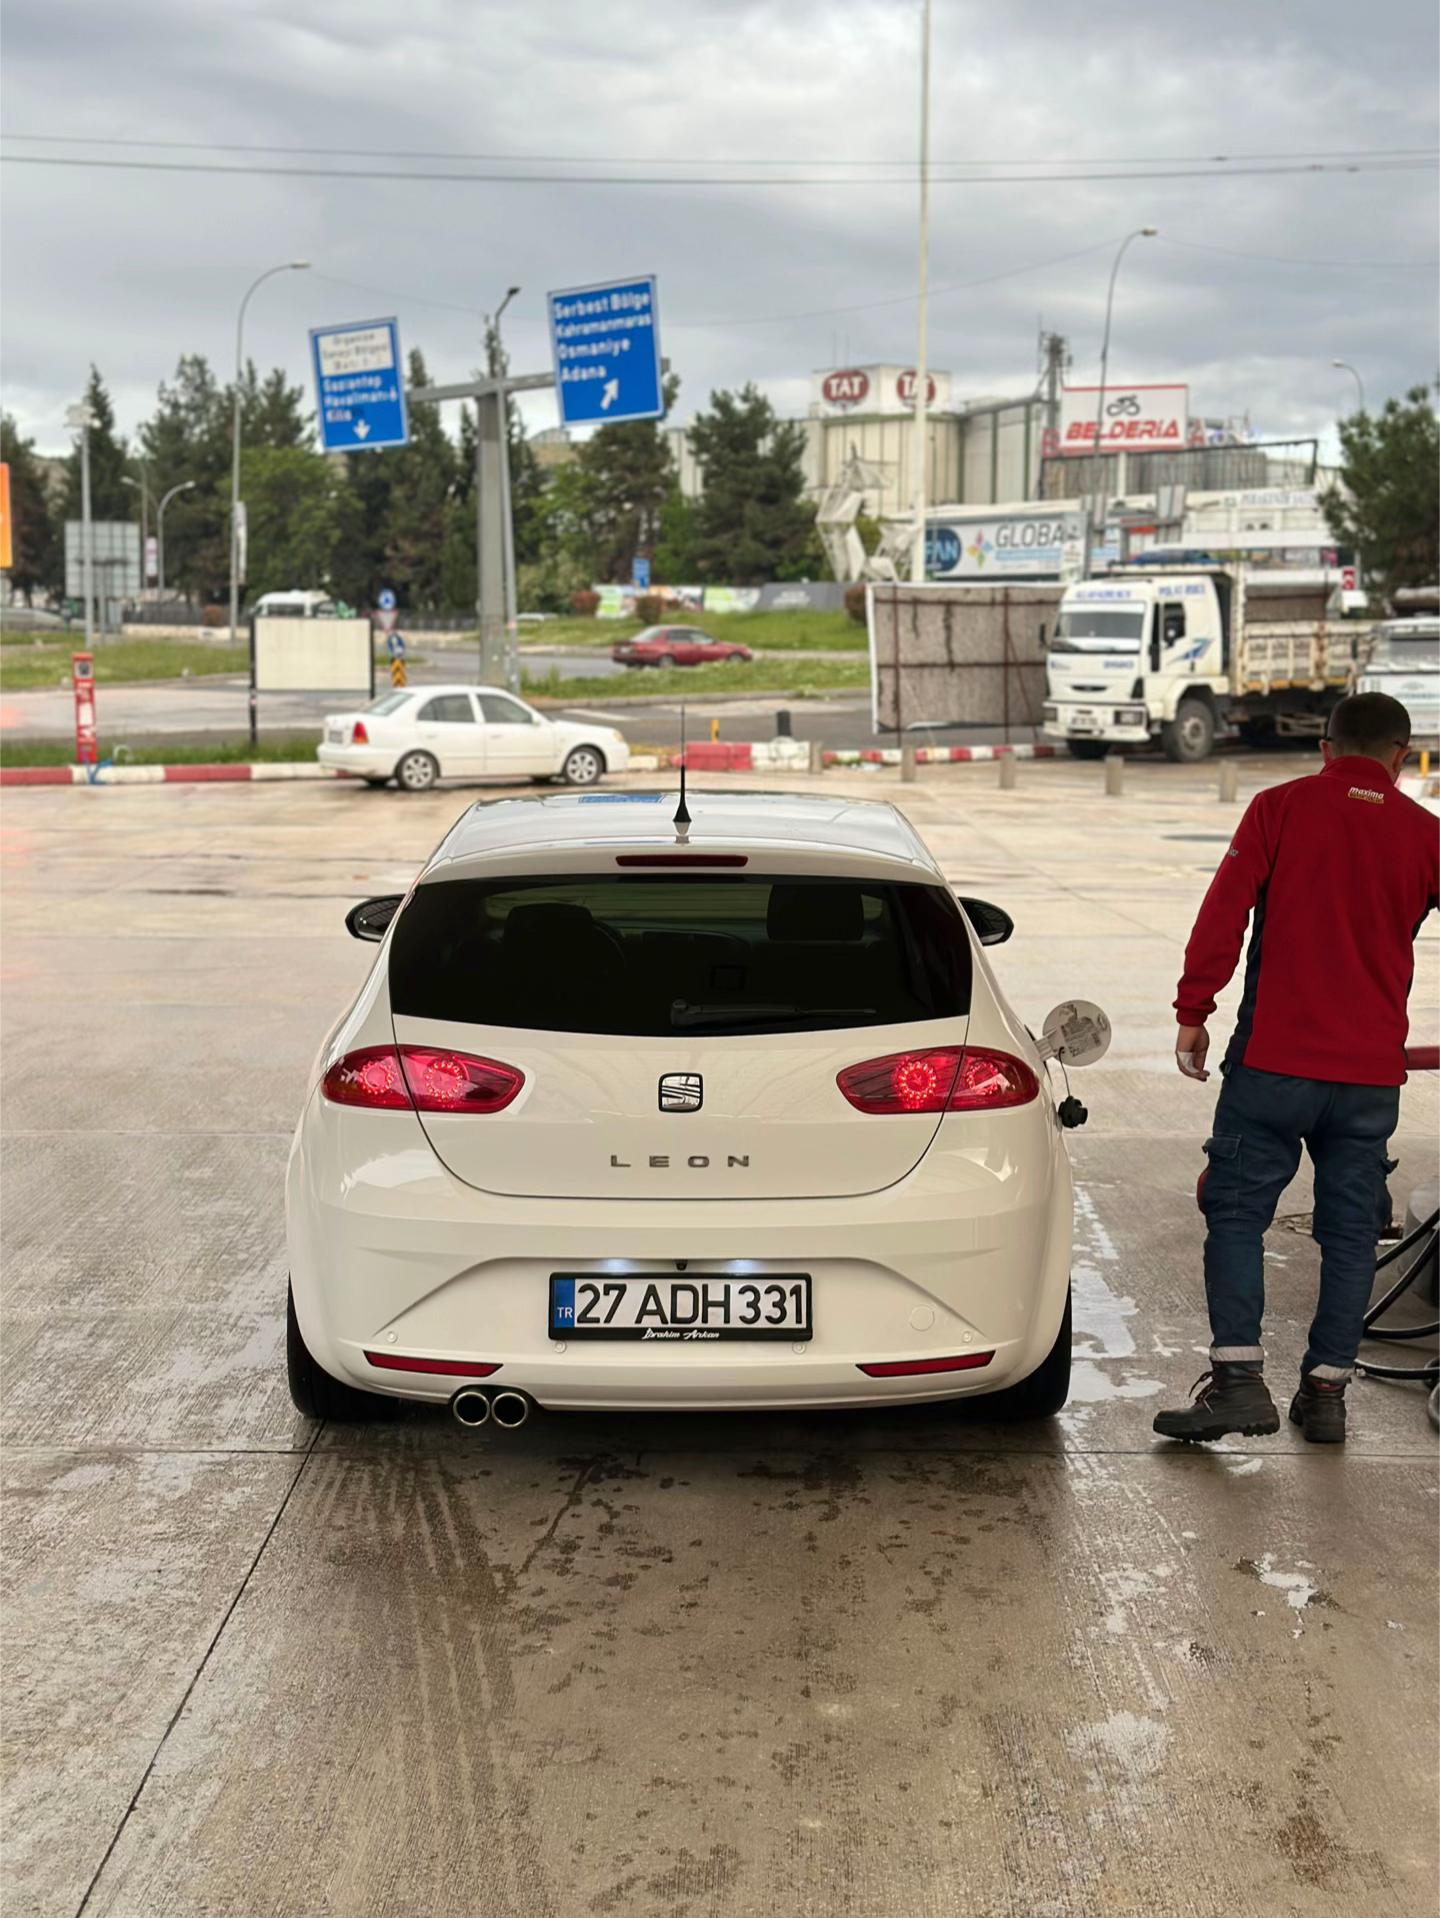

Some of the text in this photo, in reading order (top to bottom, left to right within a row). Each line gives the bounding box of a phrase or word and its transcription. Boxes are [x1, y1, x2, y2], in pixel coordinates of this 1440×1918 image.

[555, 297, 609, 320] Serbest
[559, 338, 631, 359] Osmaniye
[561, 365, 607, 381] Adana
[829, 377, 863, 397] TAT
[995, 523, 1066, 549] GLOBA
[1349, 787, 1385, 799] maxima
[610, 1155, 750, 1168] LEON
[557, 1307, 573, 1319] TR
[577, 1284, 802, 1325] 27 ADH 331
